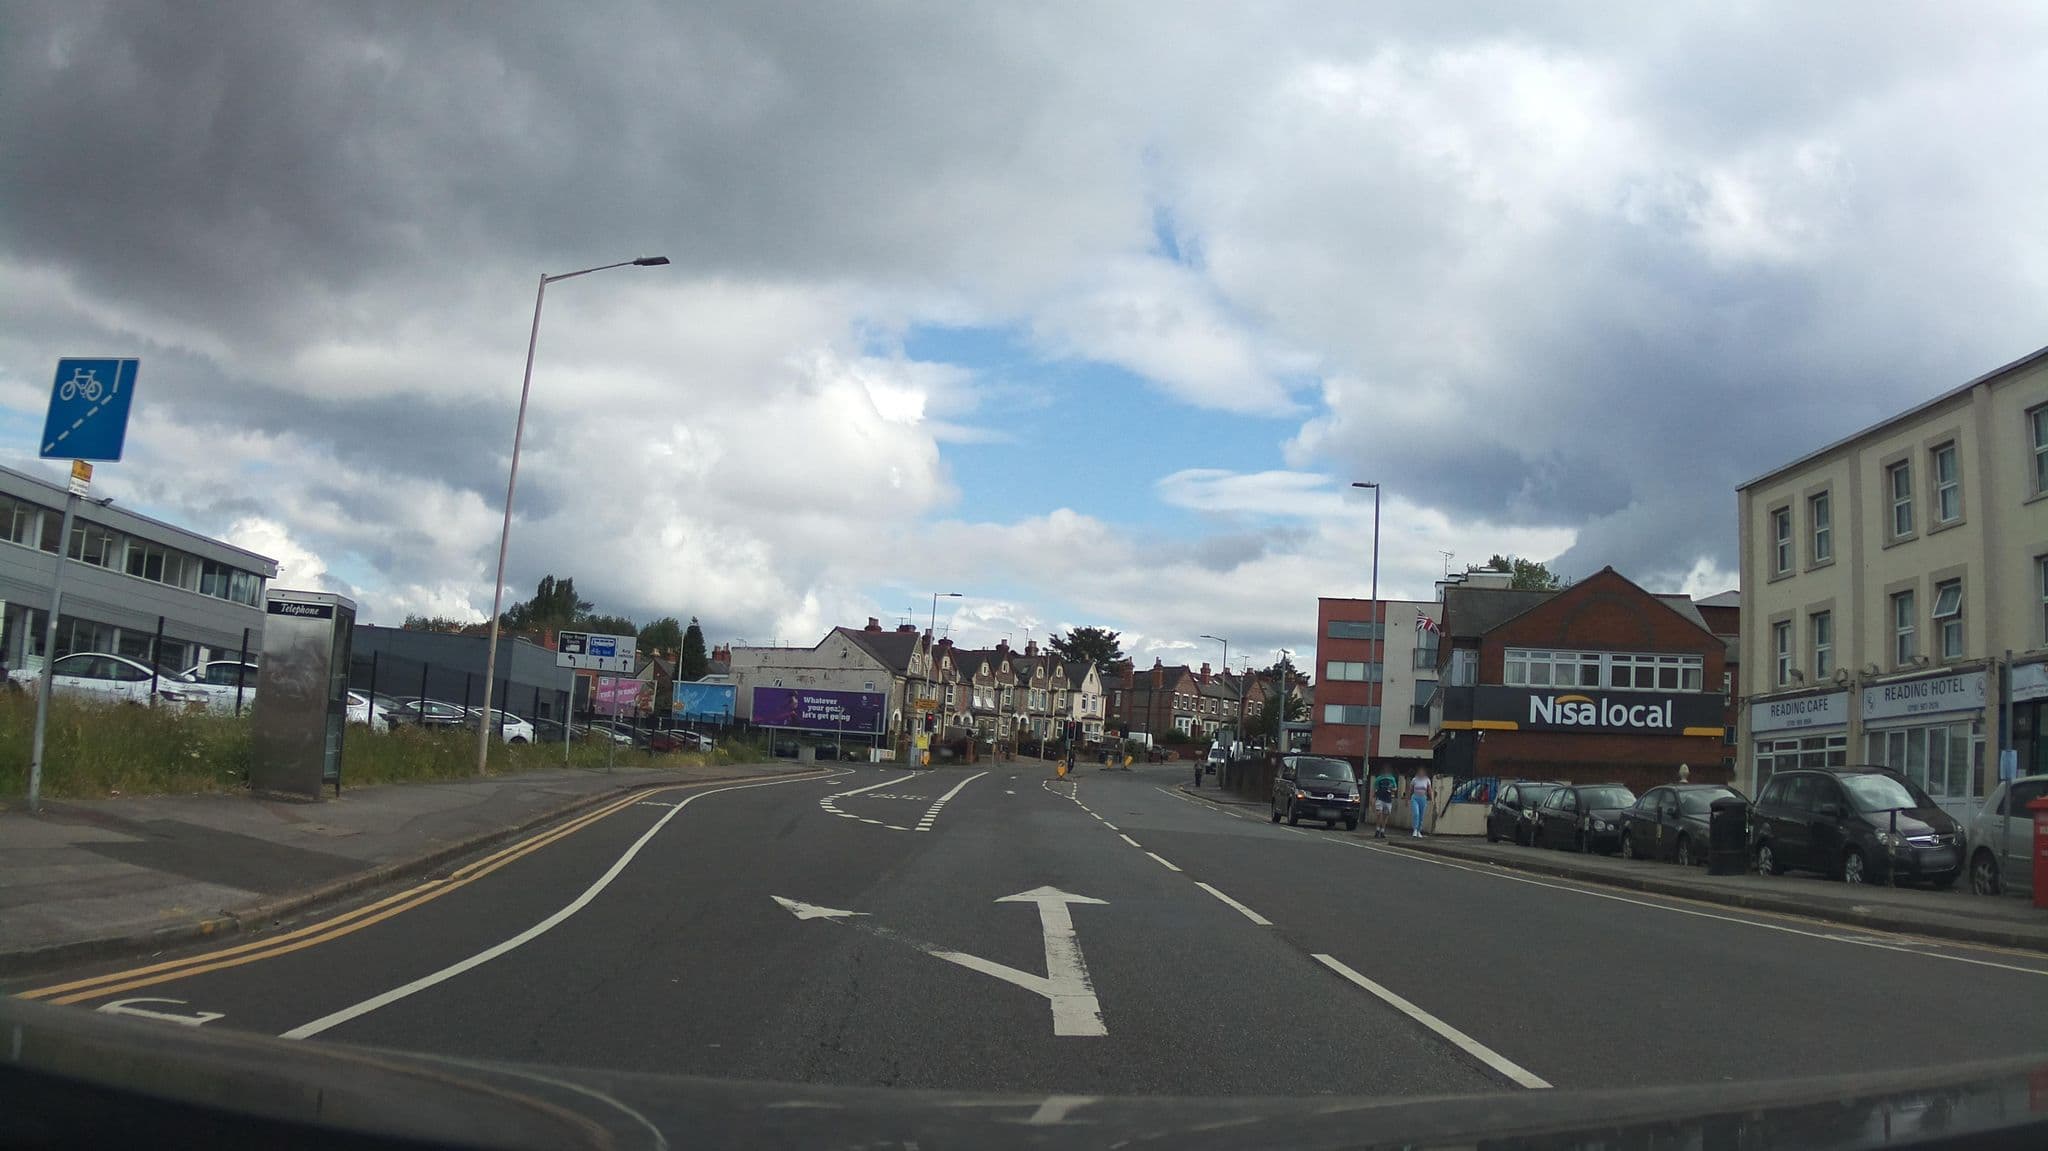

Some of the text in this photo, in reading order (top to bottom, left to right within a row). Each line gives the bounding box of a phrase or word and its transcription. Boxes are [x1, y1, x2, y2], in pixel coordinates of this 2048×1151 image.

[281, 604, 319, 615] Telephone
[1885, 679, 1965, 702] READING HOTEL
[803, 696, 838, 705] Whatever
[807, 704, 824, 712] your
[1529, 695, 1673, 728] Nisa local
[1770, 702, 1805, 718] READING
[802, 711, 816, 719] let's
[817, 712, 829, 720] get
